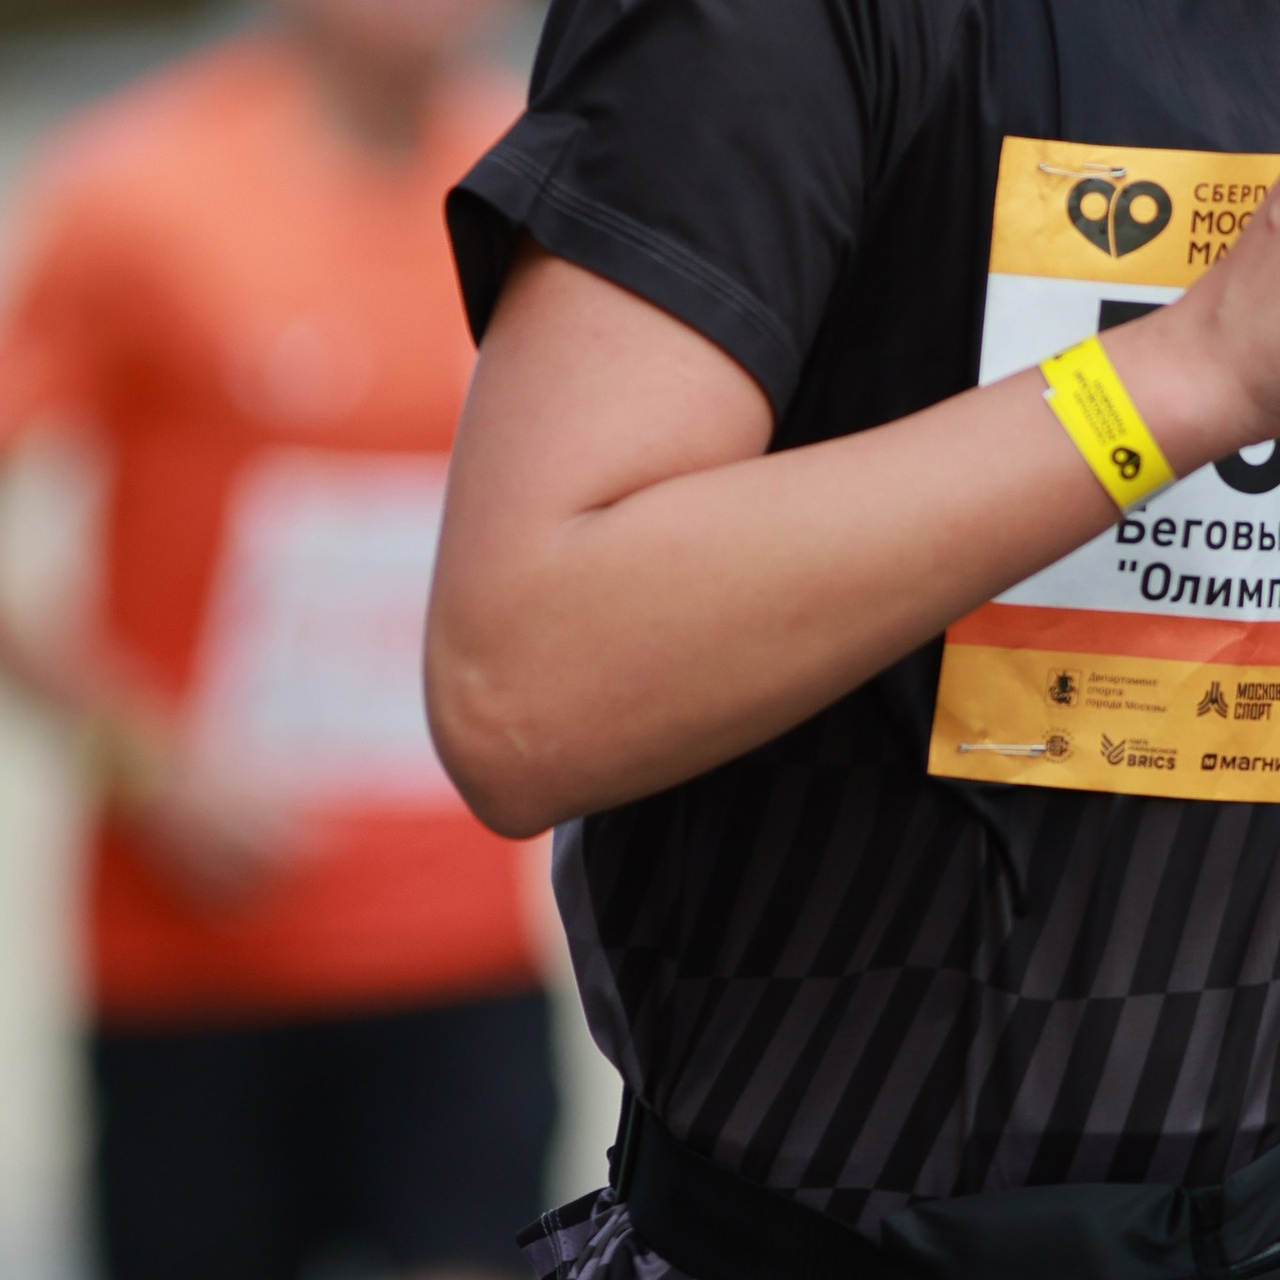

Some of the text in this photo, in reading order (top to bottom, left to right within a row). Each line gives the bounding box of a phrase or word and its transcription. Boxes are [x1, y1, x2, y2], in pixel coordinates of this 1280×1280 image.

[1194, 182, 1268, 203] СБЕРП
[1234, 702, 1272, 721] СПОРТ
[1127, 754, 1176, 770] BRICS
